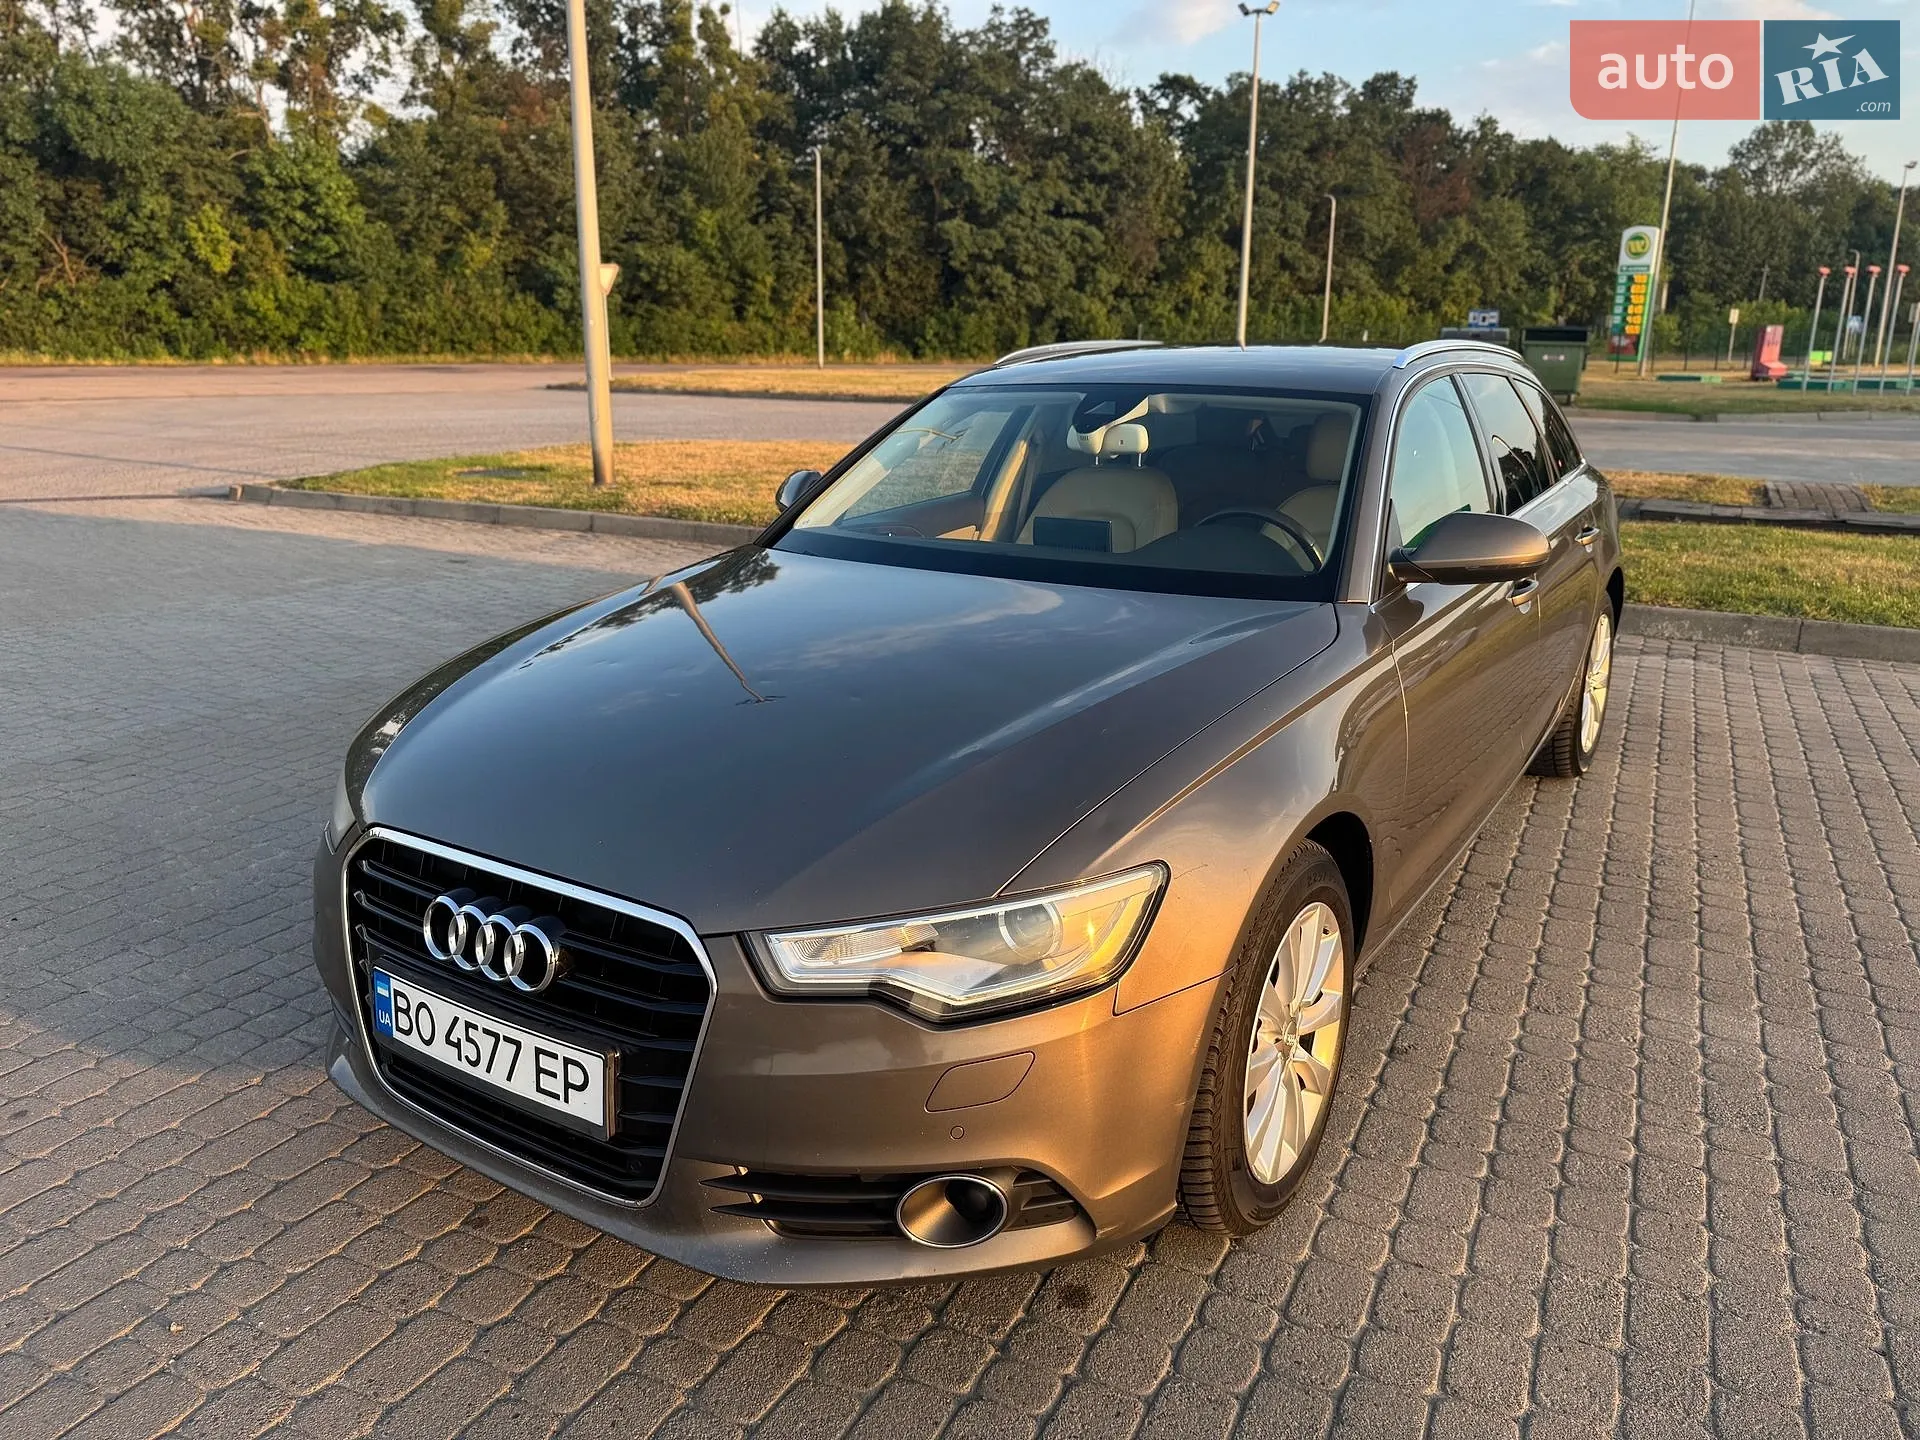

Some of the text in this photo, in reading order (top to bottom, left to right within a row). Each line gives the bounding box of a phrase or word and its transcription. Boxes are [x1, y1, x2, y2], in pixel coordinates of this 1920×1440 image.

[378, 1008, 391, 1027] UA
[393, 988, 590, 1104] BO 4577 EP
